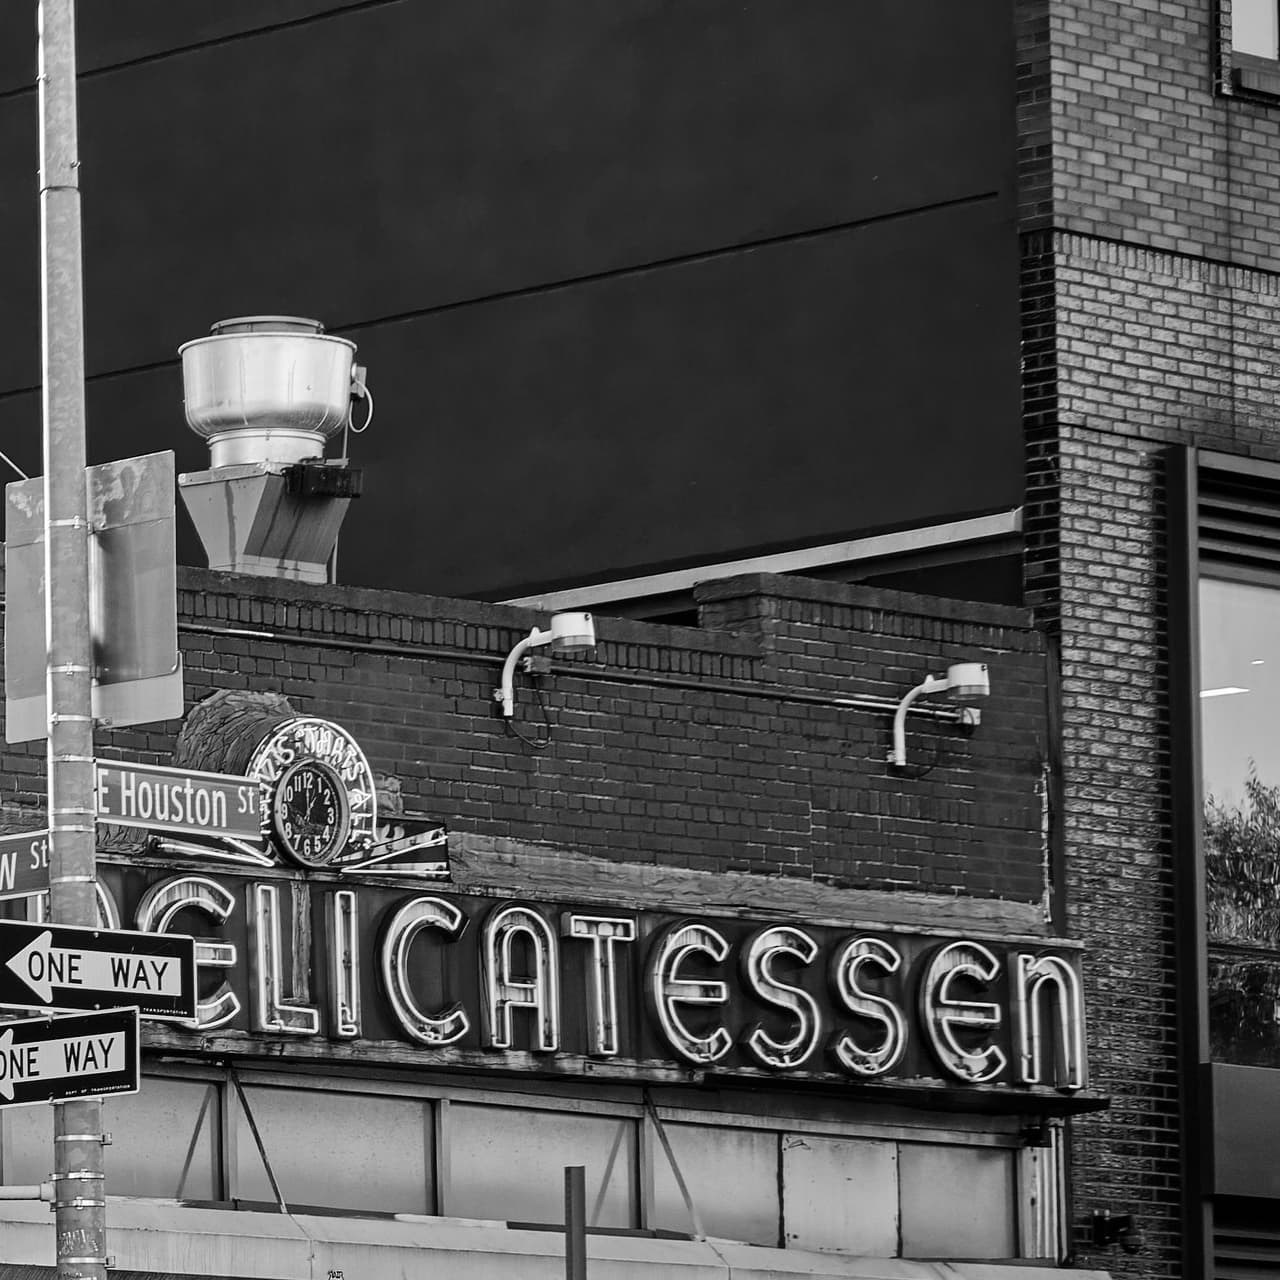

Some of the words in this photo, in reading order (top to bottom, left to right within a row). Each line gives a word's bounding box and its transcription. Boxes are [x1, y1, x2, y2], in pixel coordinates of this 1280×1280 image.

[294, 775, 302, 792] 11
[303, 772, 313, 789] 12
[317, 777, 322, 793] 1
[97, 767, 109, 813] E
[121, 770, 228, 829] Houston
[238, 785, 255, 815] St
[283, 786, 293, 802] 10
[323, 789, 331, 805] 2
[281, 803, 288, 819] 9
[327, 808, 334, 824] 3
[285, 822, 292, 839] 8
[322, 825, 330, 842] 4
[294, 834, 302, 850] 7
[303, 839, 310, 856] 6
[314, 835, 321, 852] 5
[30, 838, 49, 872] St
[27, 950, 83, 986] ONE
[110, 957, 170, 994] WAY
[63, 1037, 115, 1073] WAY
